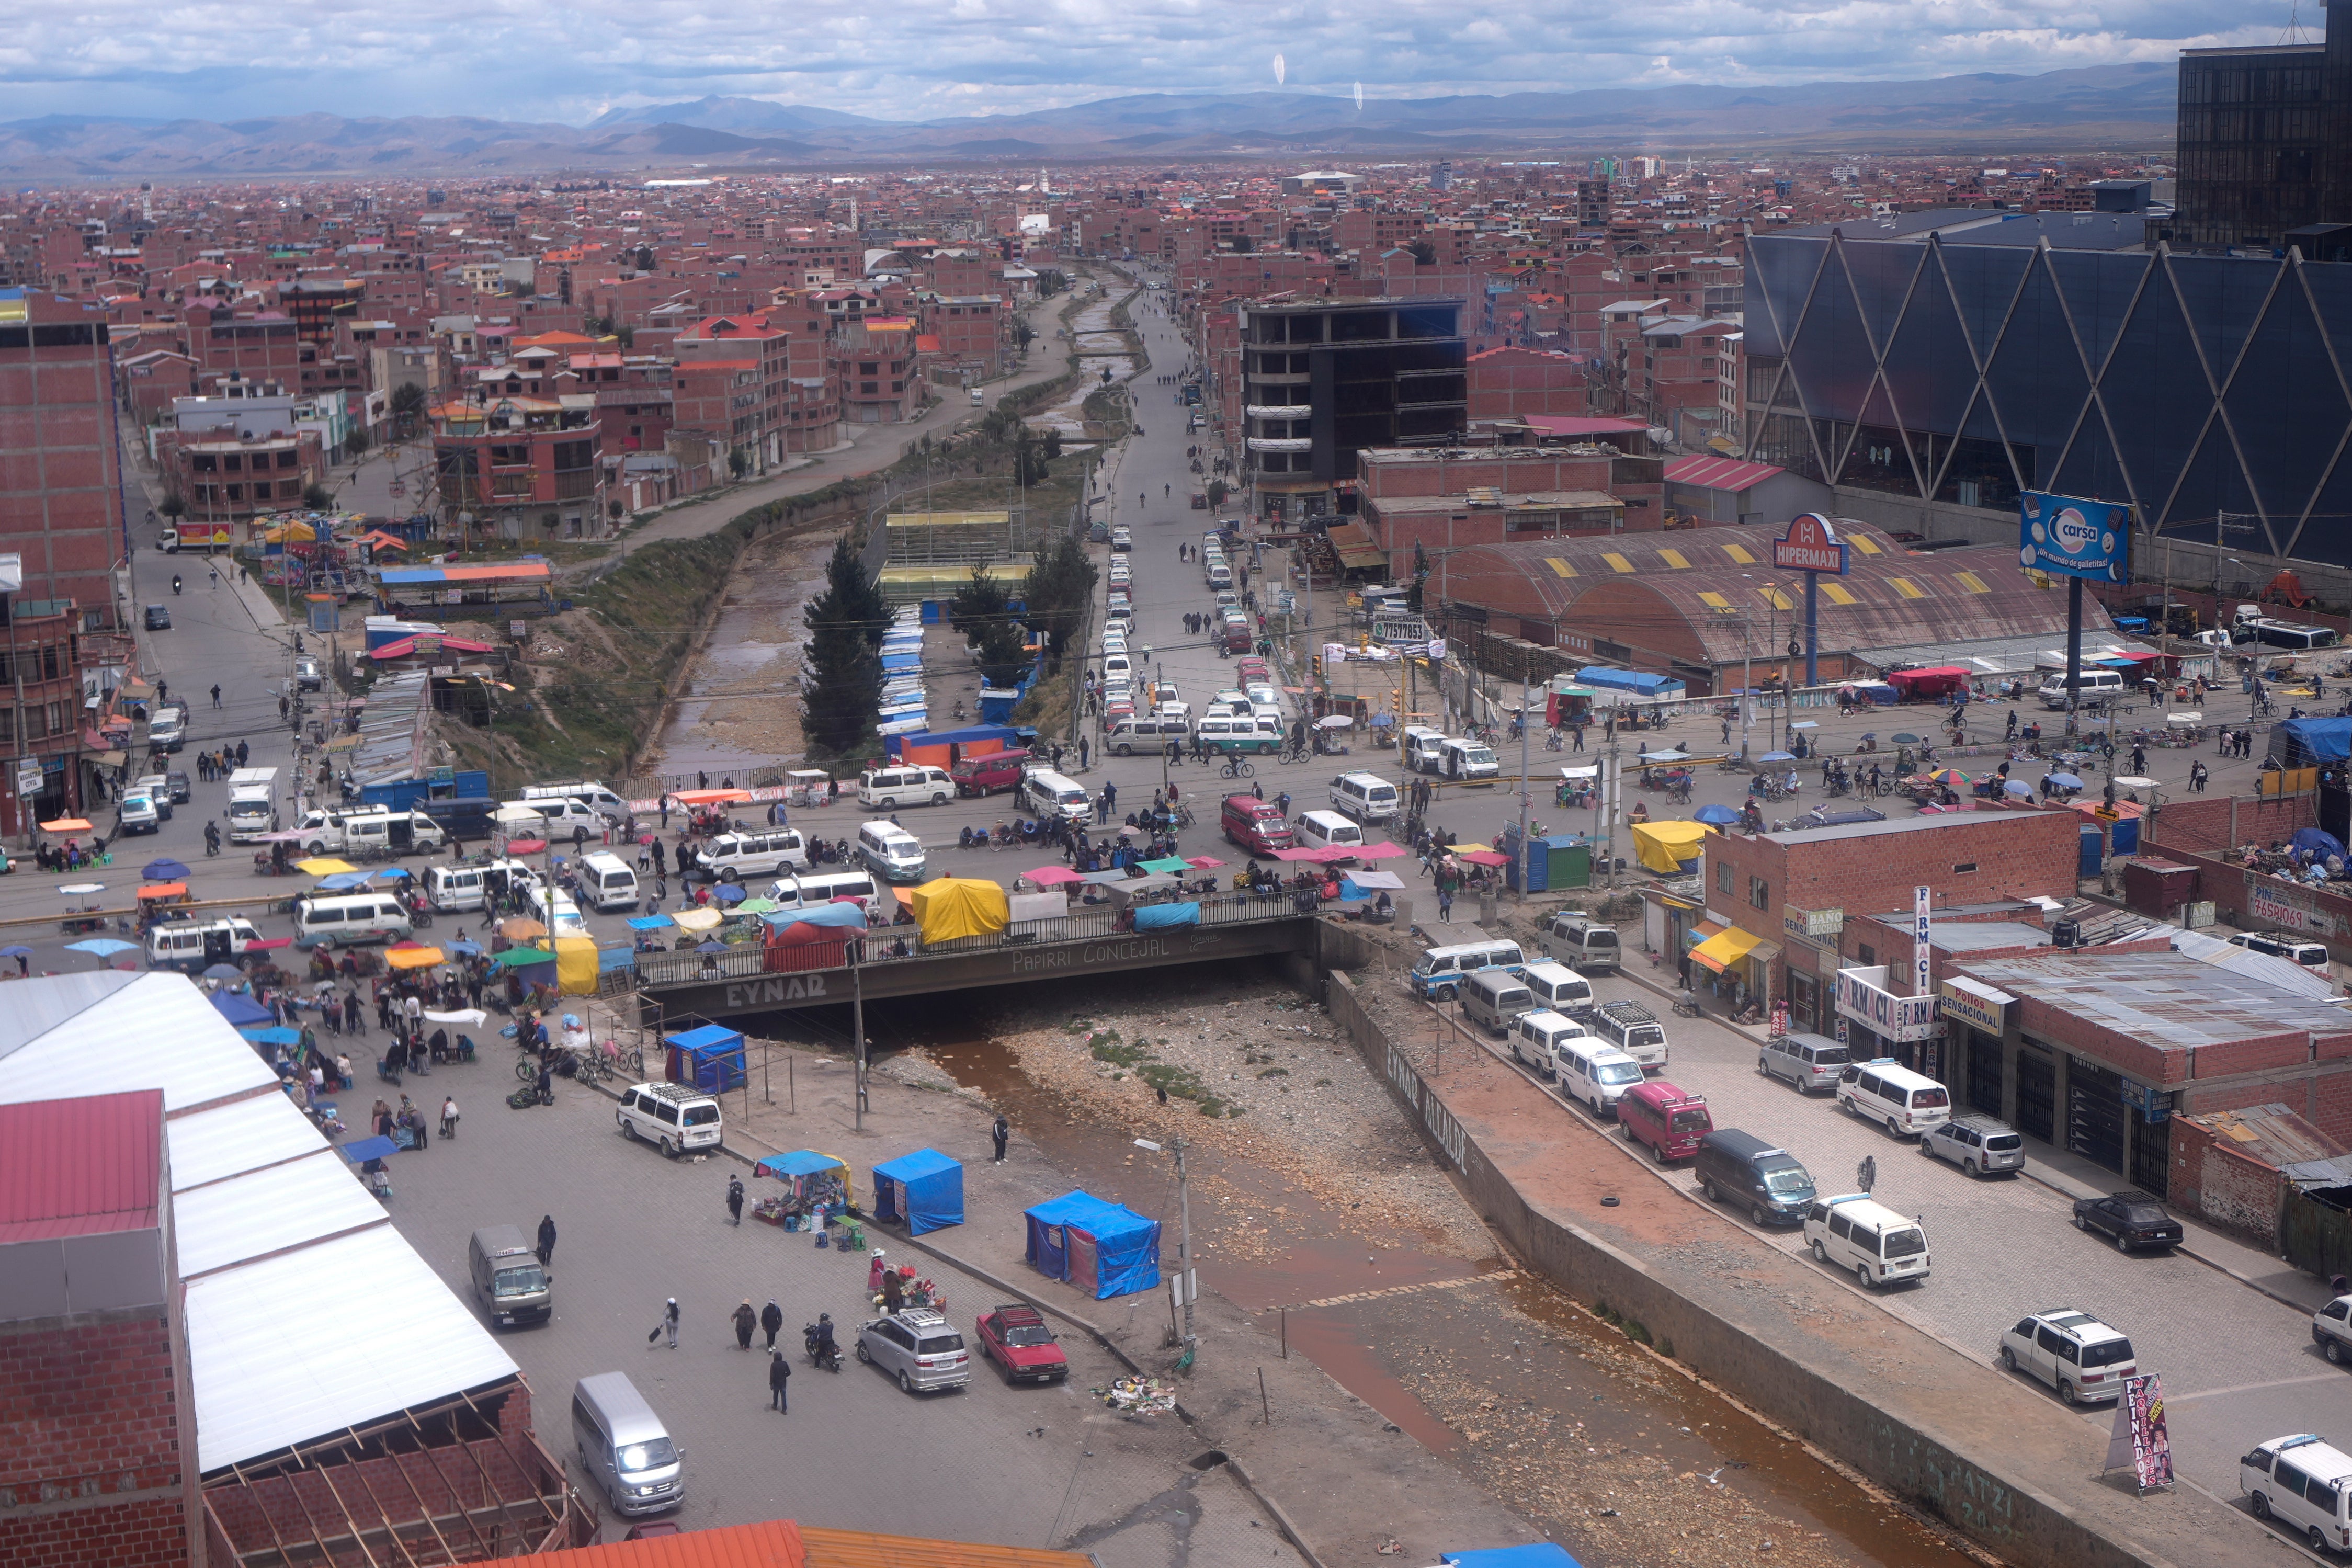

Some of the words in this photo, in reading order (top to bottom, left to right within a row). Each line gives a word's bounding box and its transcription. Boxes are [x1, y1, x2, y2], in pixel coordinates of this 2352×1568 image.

[2063, 524, 2096, 540] carsa
[1777, 546, 1838, 568] HIPERMAXI
[2048, 553, 2069, 565] mundo
[2077, 558, 2108, 569] galletitas!
[1383, 622, 1423, 639] 77577853
[19, 770, 41, 781] REGISTRO
[25, 779, 37, 788] CIVIL
[1809, 910, 1843, 925] BAÑO
[2190, 904, 2215, 917] AÑO
[1809, 922, 1843, 935] DUCHAS
[2190, 916, 2215, 928] UCHAS
[1084, 938, 1169, 963] CONCEJAL
[726, 974, 826, 1007] EYNAR
[1837, 972, 1896, 1031] FARMACIA
[1942, 995, 1997, 1029] SENSACIONAL
[1771, 1011, 1780, 1035] BAÑO
[1388, 1043, 1418, 1110] EYNAR
[2123, 1079, 2129, 1089] EL
[2152, 1102, 2172, 1110] AMIGO
[2144, 1374, 2158, 1395] CORTES
[2146, 1387, 2160, 1407] TINTES
[2150, 1403, 2164, 1423] FACIAL
[2127, 1381, 2146, 1487] PEINADOS
[2134, 1379, 2156, 1485] MAQUILLAJES
